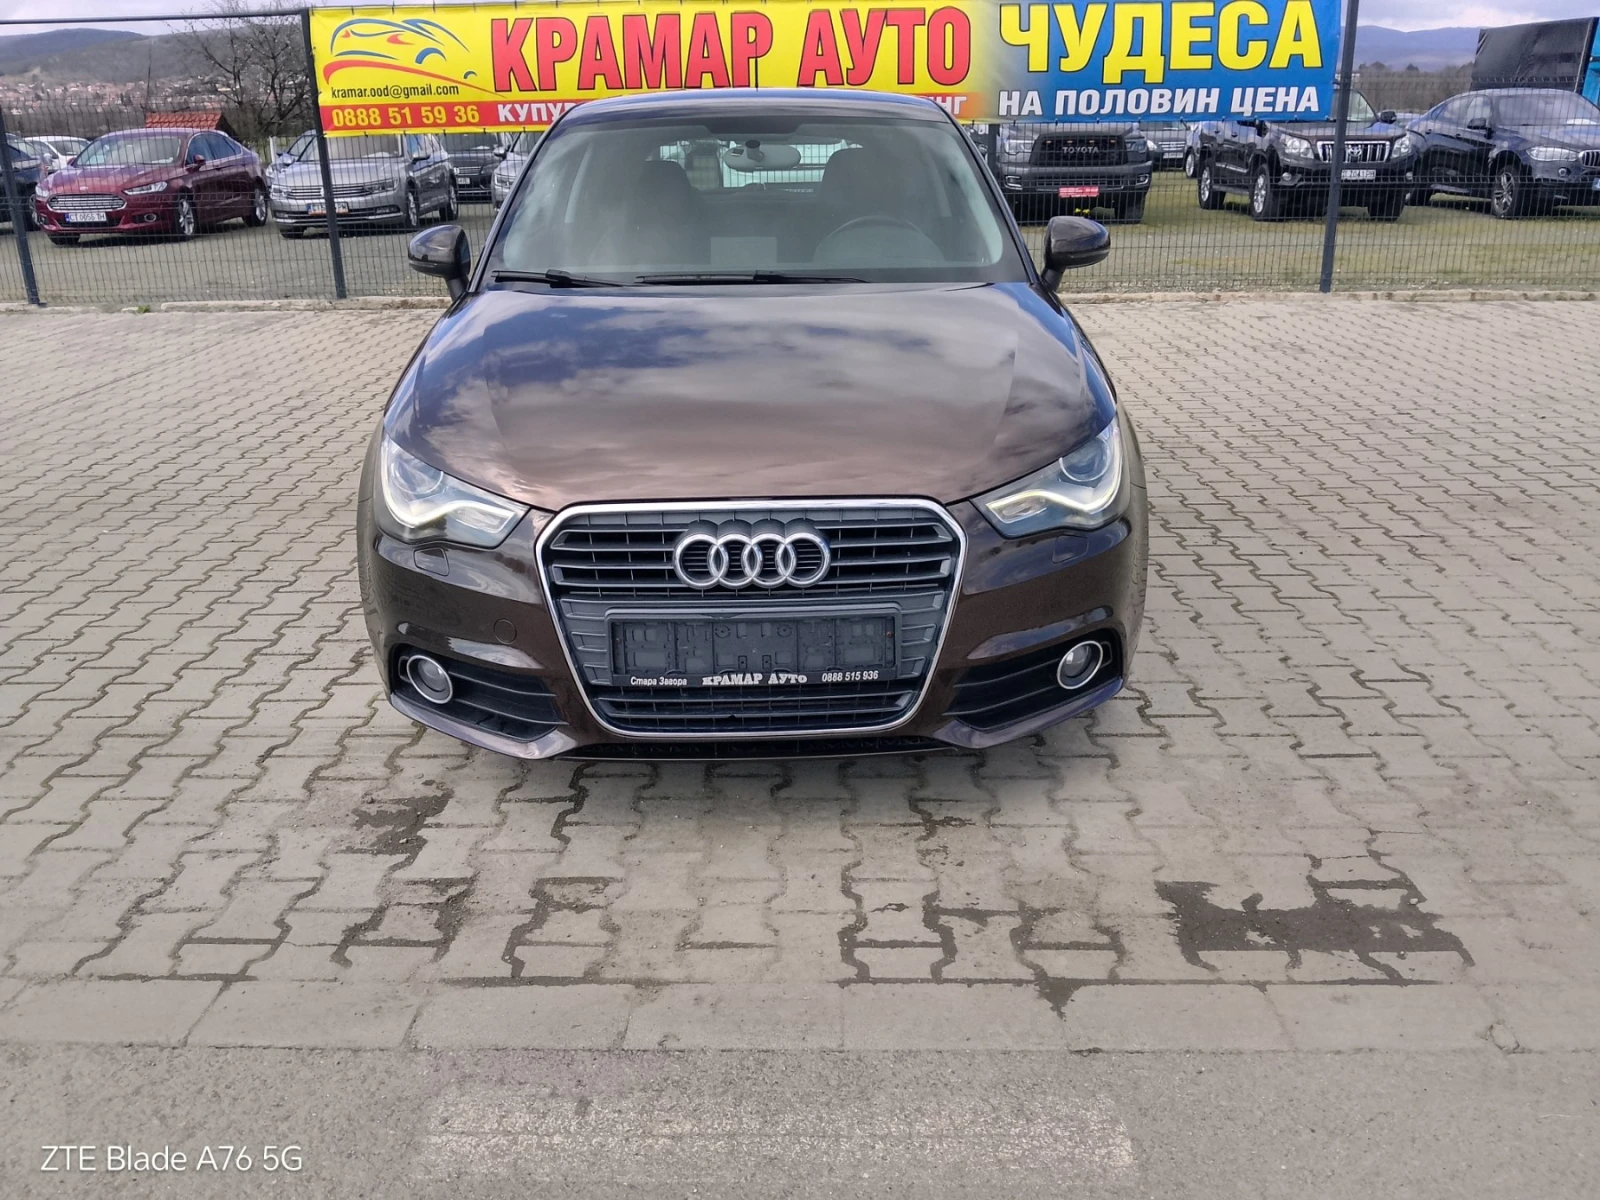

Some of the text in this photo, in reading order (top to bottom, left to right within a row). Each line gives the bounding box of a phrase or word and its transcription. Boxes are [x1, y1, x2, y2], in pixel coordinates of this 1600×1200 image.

[490, 6, 971, 93] КРАМАР АУТО
[999, 0, 1322, 84] ЧУДЕСА
[331, 84, 459, 99] kramar.ood@gmail.com
[998, 86, 1319, 117] НА ПОЛОВИН ЦЕНА
[331, 105, 480, 127] 0888 51 59 36
[1062, 146, 1099, 154] TOYOTA
[630, 670, 879, 686] Стара Загора КРАМАР АУТО 0888 515 936
